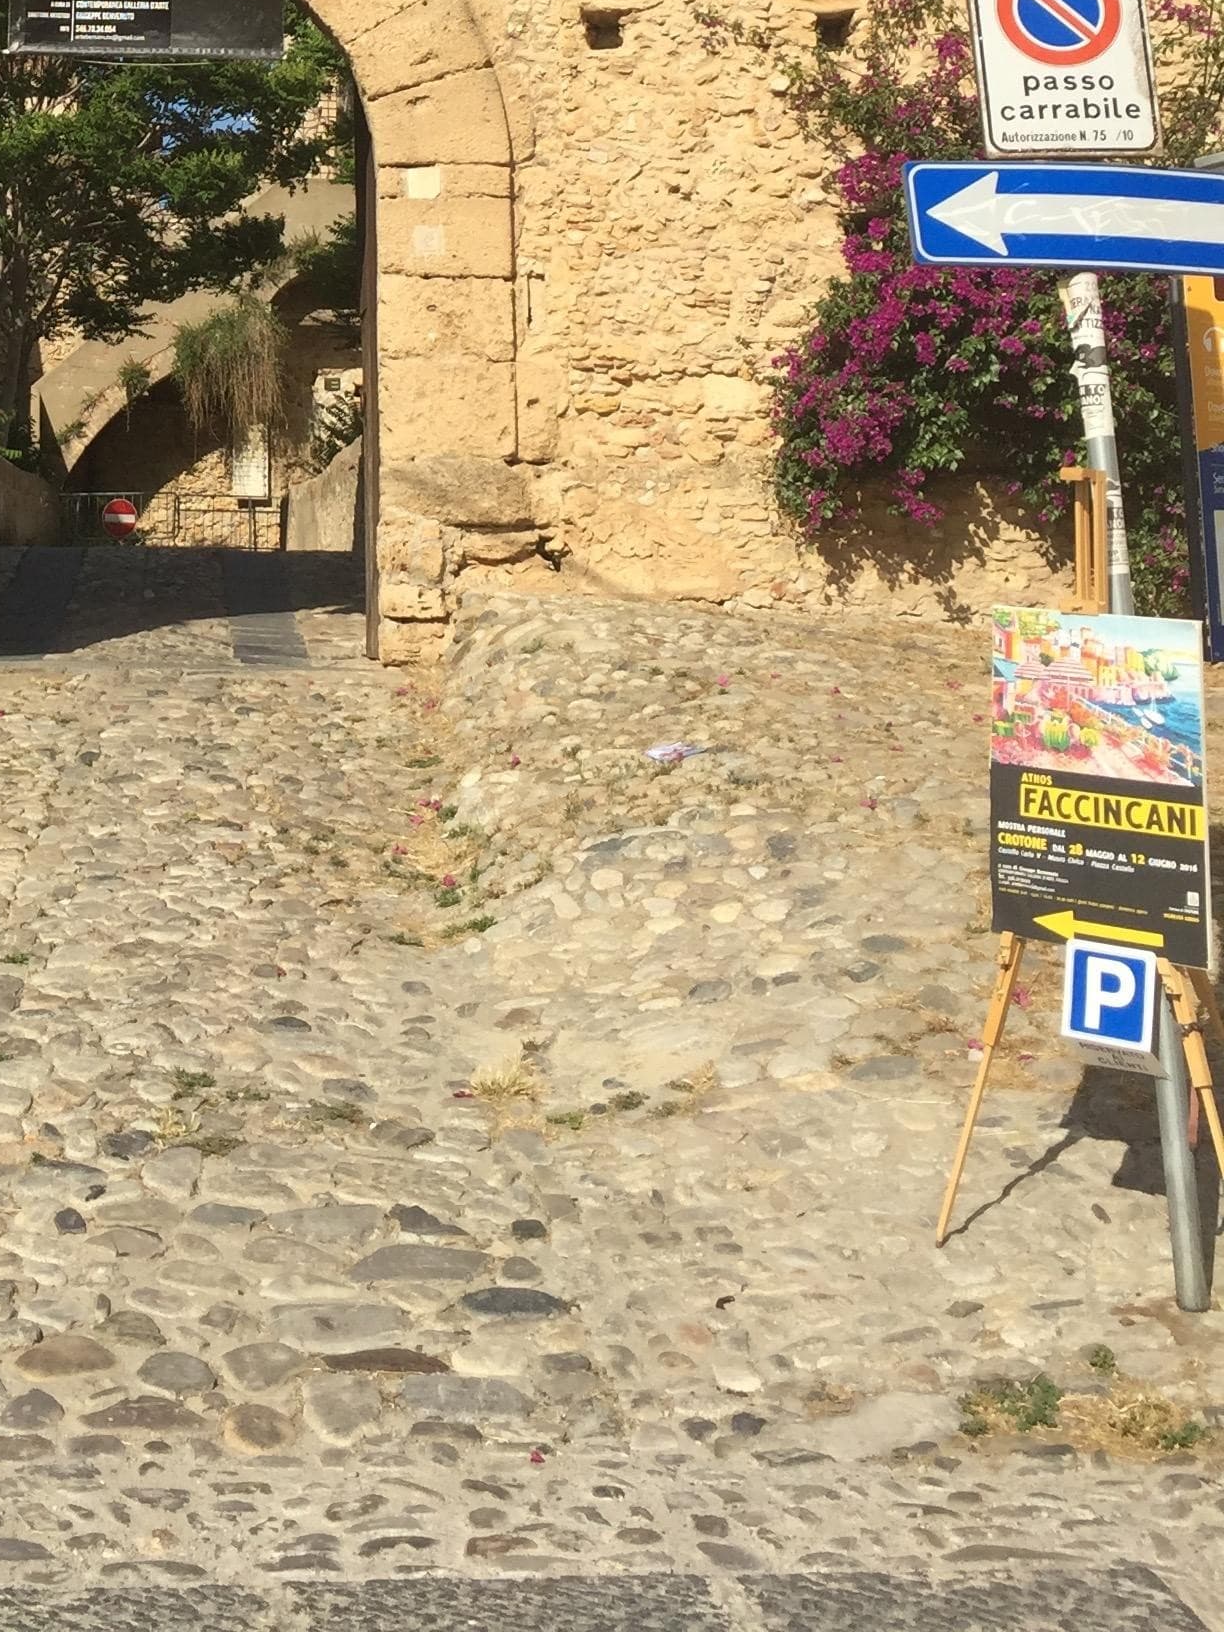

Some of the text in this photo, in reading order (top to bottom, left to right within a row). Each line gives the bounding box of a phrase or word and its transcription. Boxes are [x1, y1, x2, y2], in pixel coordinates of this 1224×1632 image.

[1022, 73, 1115, 96] passo
[1000, 98, 1141, 122] carrabile
[1001, 130, 1077, 143] Autorizzazione
[1092, 129, 1107, 141] 75
[1021, 772, 1053, 786] ATHOS
[1023, 787, 1197, 837] FACCINCANI
[998, 820, 1066, 838] MOSTRA PERSONALE
[997, 831, 1198, 873] CROTONE DAL 28 MAGGIO AL 12 GIUGNO 2016
[1084, 955, 1136, 1030] P
